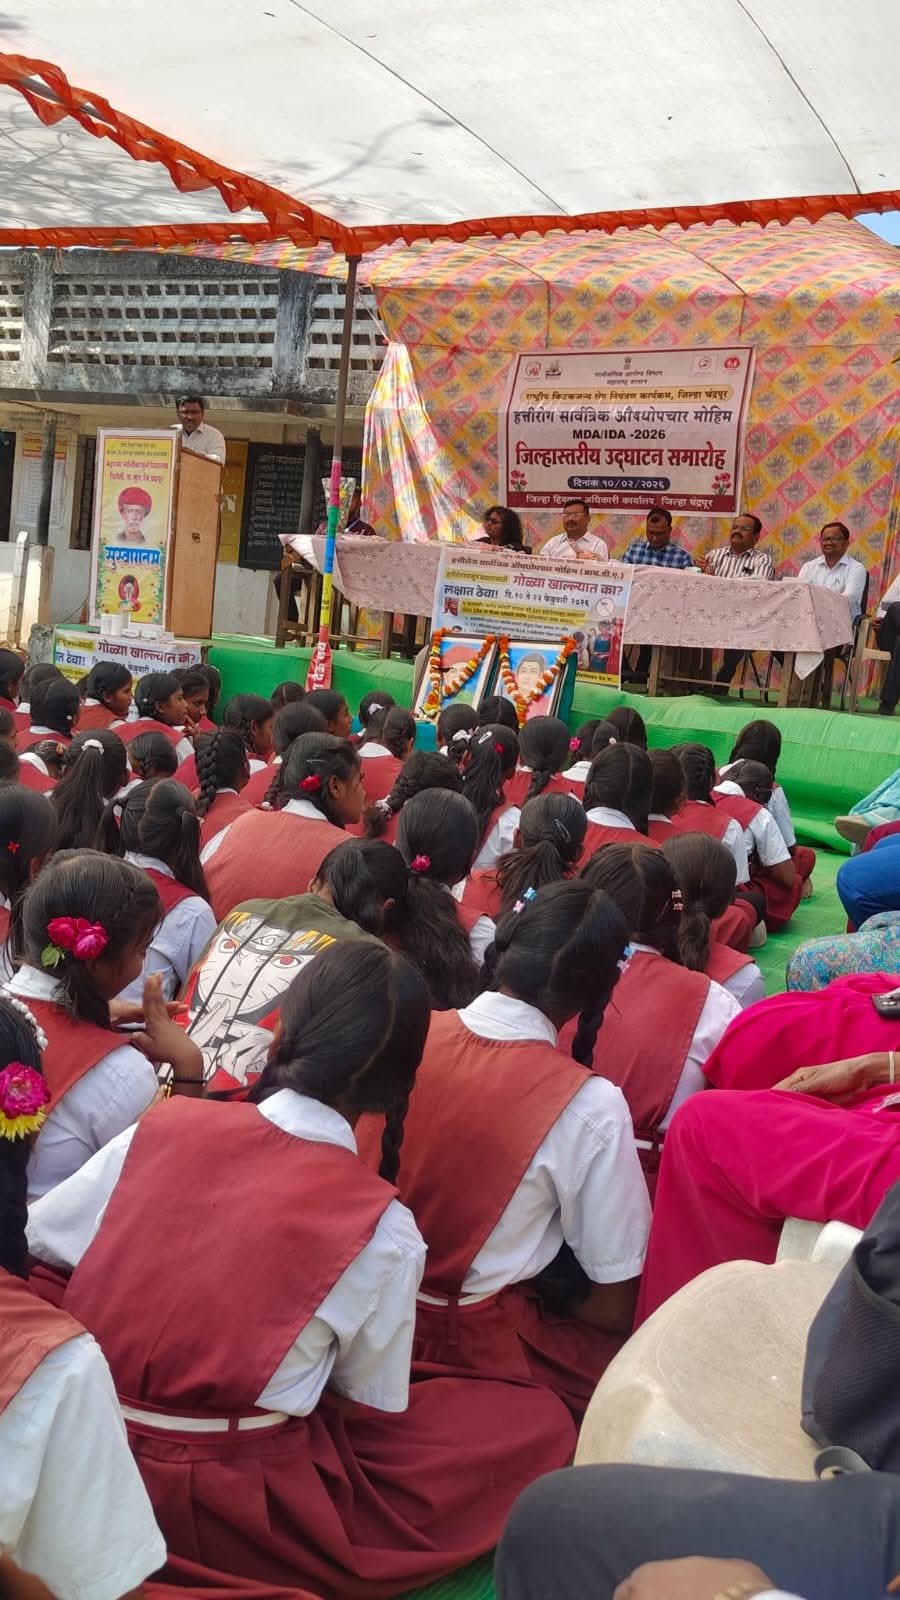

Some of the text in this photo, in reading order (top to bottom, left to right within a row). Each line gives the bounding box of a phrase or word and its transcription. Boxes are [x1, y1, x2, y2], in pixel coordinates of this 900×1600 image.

[678, 389, 702, 399] जिल्हा
[705, 387, 728, 401] चंद्रपूर
[514, 405, 732, 424] हत्तीरोग सार्वत्रिक औषधोपचार मोहिम
[572, 429, 666, 440] MDA/IDA -2026
[515, 441, 601, 468] जिल्हास्तरीय
[667, 441, 727, 470] समारोह
[573, 477, 598, 488] दिनांक
[526, 493, 550, 504] जिल्हा
[585, 494, 619, 504] अधिकारी
[661, 496, 686, 507] जिल्हा
[444, 584, 474, 597] लक्षात
[475, 584, 498, 599] ठेवा!
[512, 573, 546, 588] गोळ्या
[547, 578, 598, 593] खाल्ल्यात
[600, 583, 624, 596] का?
[66, 650, 86, 666] ठेवा!
[98, 638, 128, 656] गोळ्या
[130, 646, 176, 664] खाल्ल्यात
